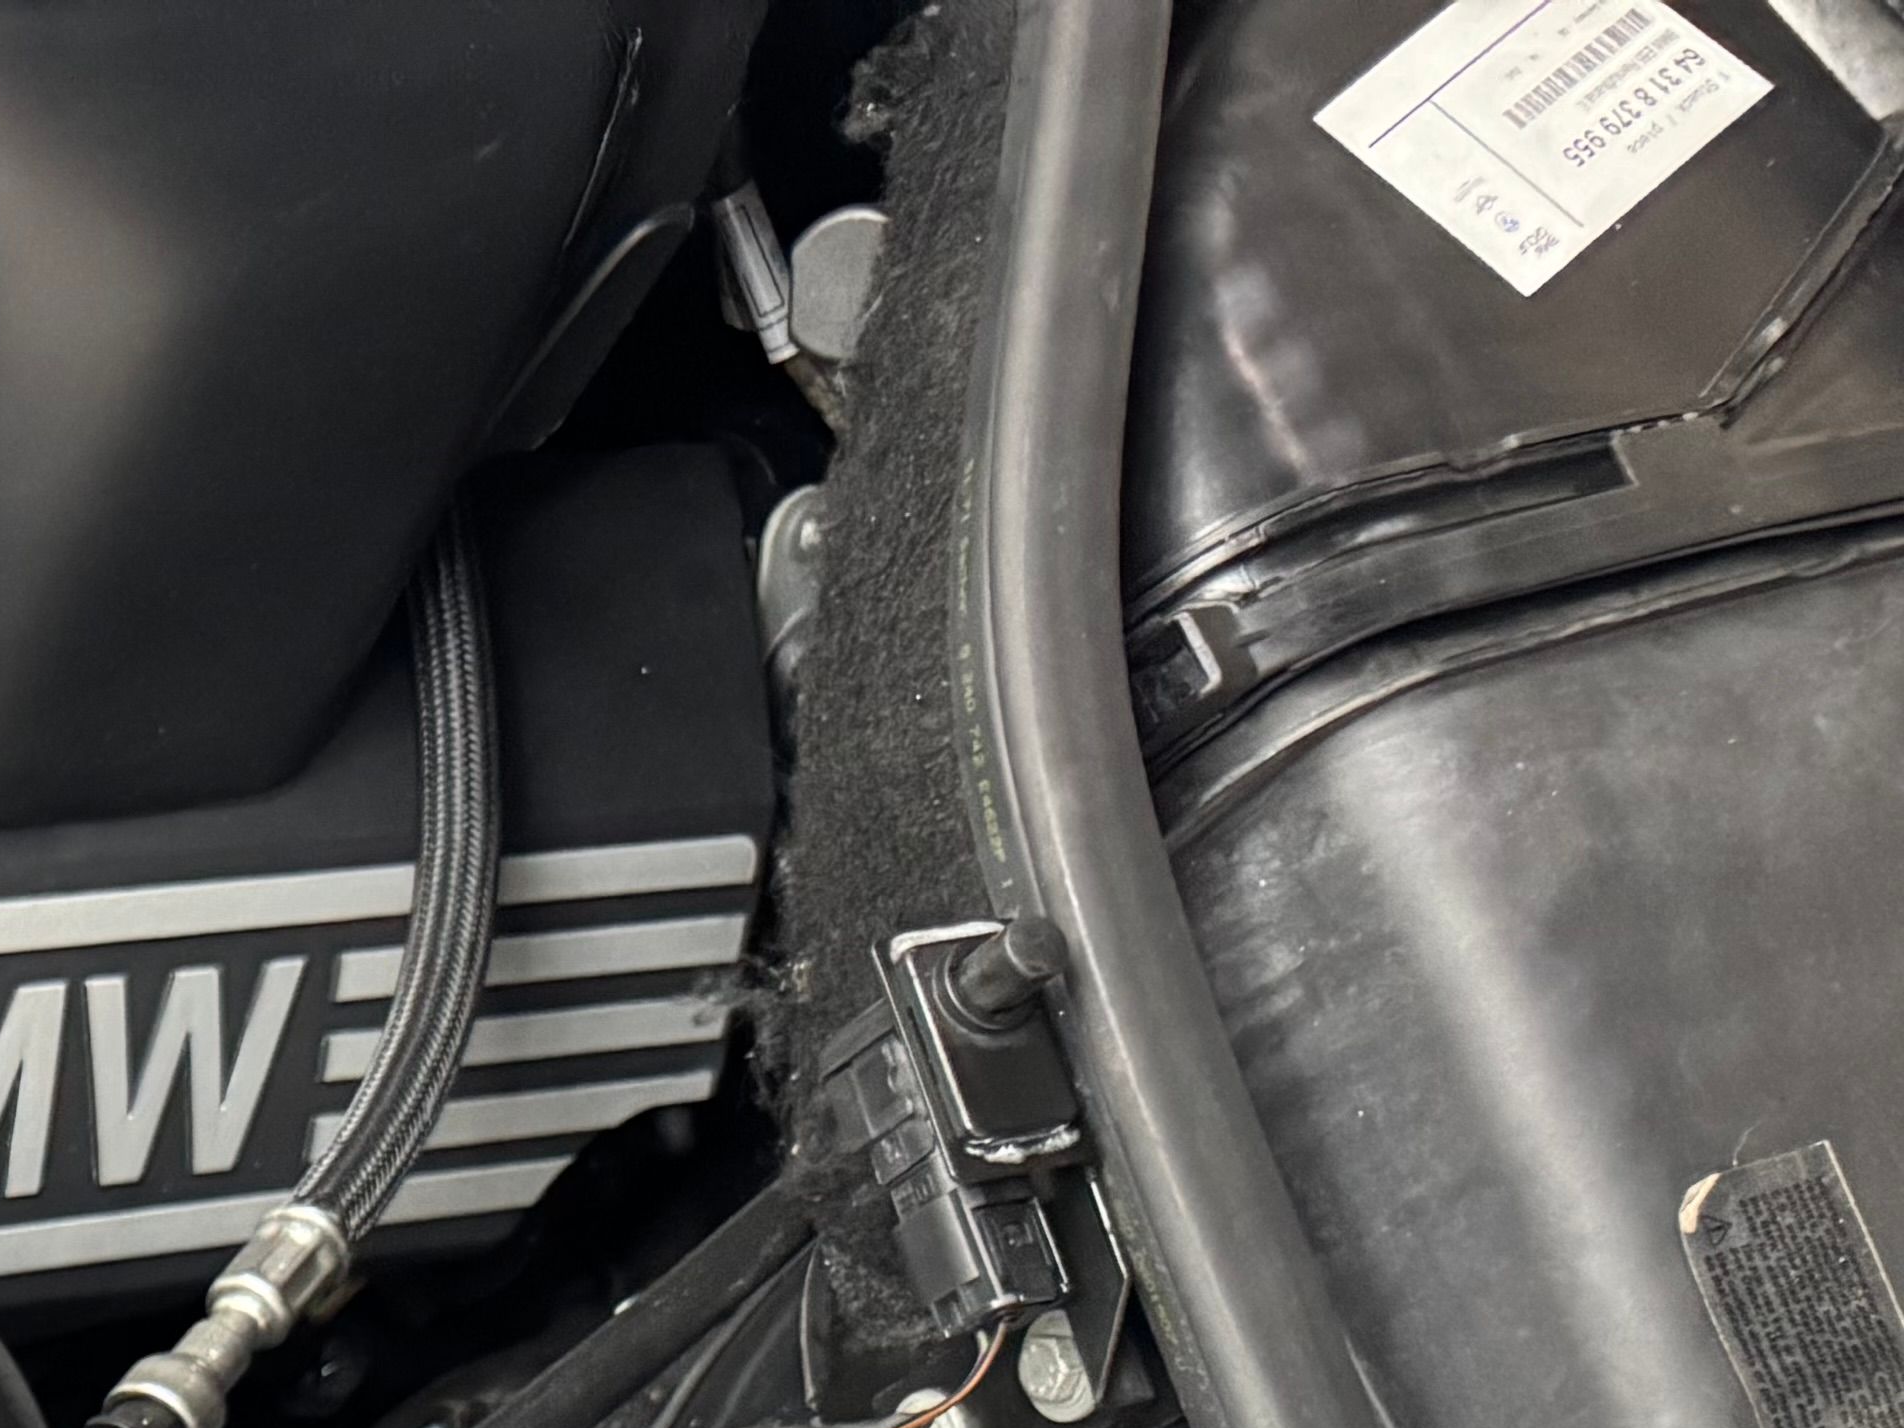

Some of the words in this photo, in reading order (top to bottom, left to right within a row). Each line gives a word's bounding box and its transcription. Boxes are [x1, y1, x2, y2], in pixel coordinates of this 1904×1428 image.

[1674, 48, 1705, 76] 64
[1649, 68, 1682, 94] 31
[1634, 88, 1657, 106] 8
[1599, 99, 1641, 135] 379
[1563, 130, 1605, 167] 955
